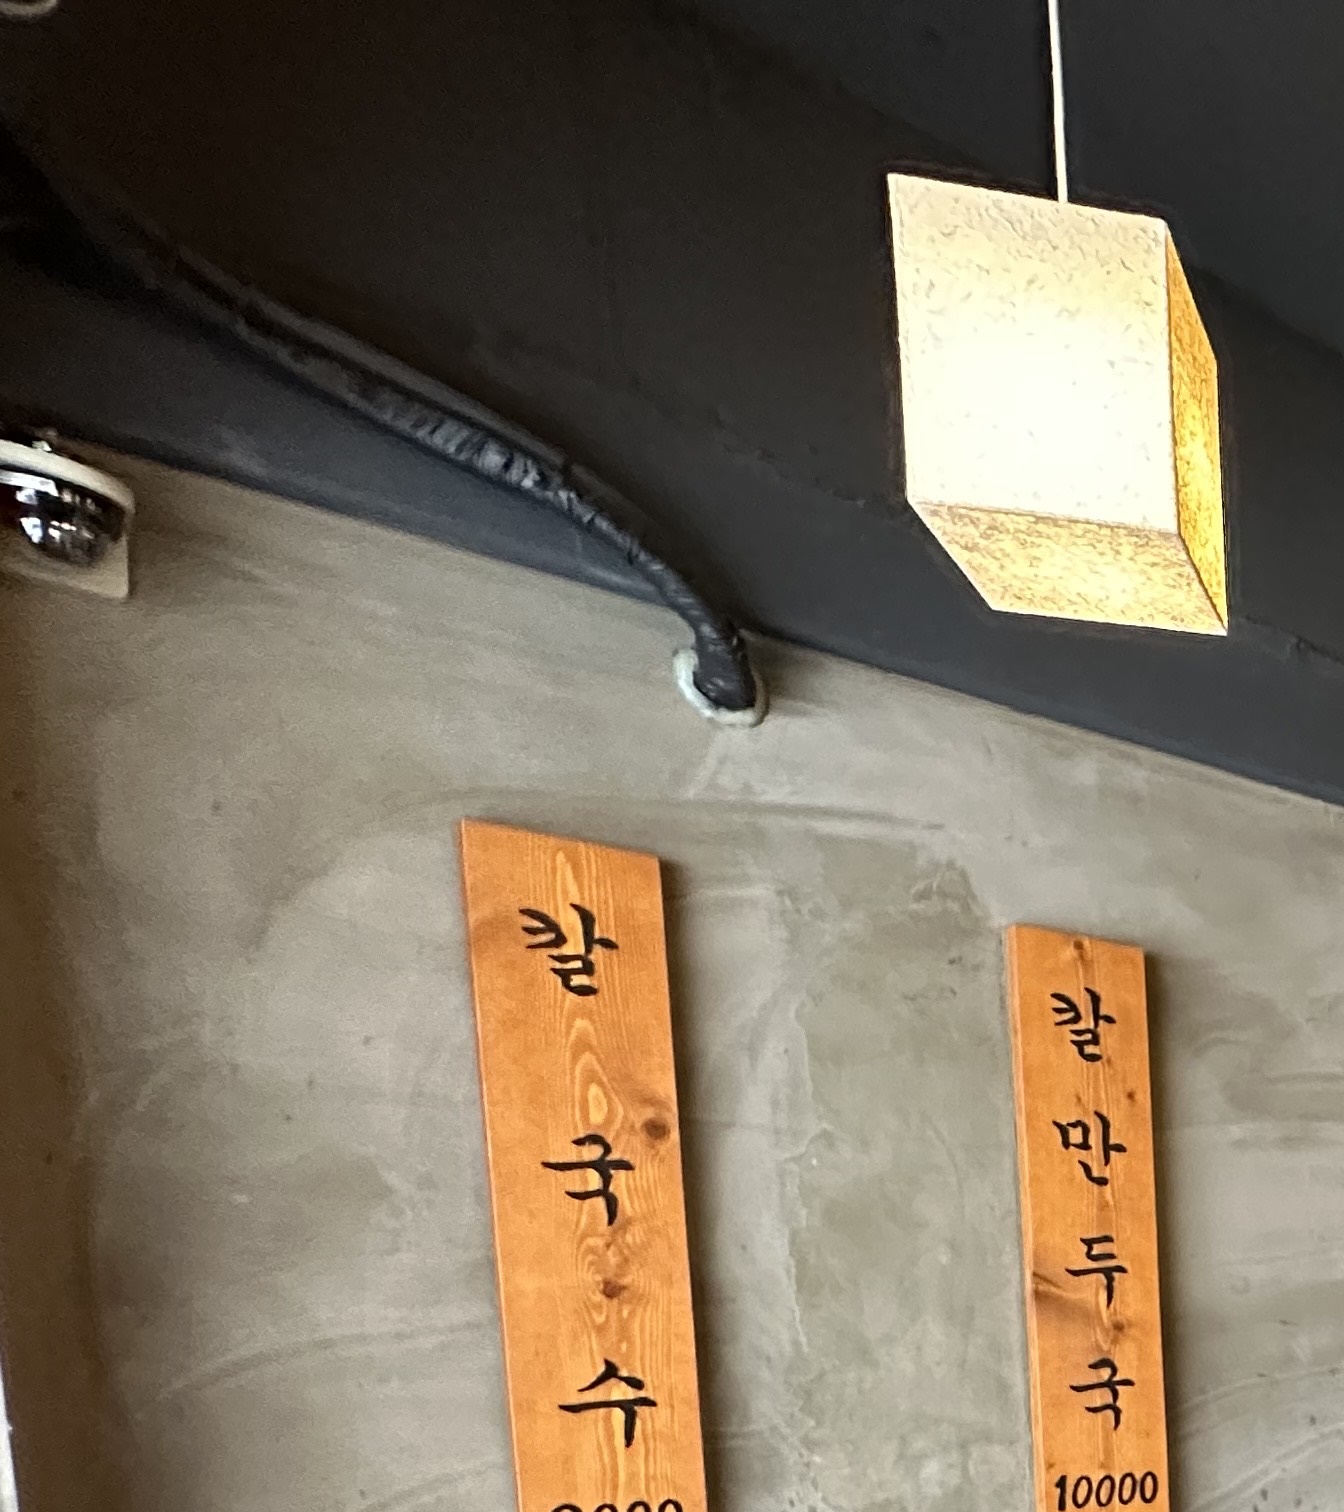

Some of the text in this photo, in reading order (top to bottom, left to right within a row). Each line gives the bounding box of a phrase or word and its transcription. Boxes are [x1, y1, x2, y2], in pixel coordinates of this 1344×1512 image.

[518, 903, 658, 1449] 칼국수
[1050, 986, 1136, 1431] 칼만두국
[1053, 1470, 1160, 1512] 10000
